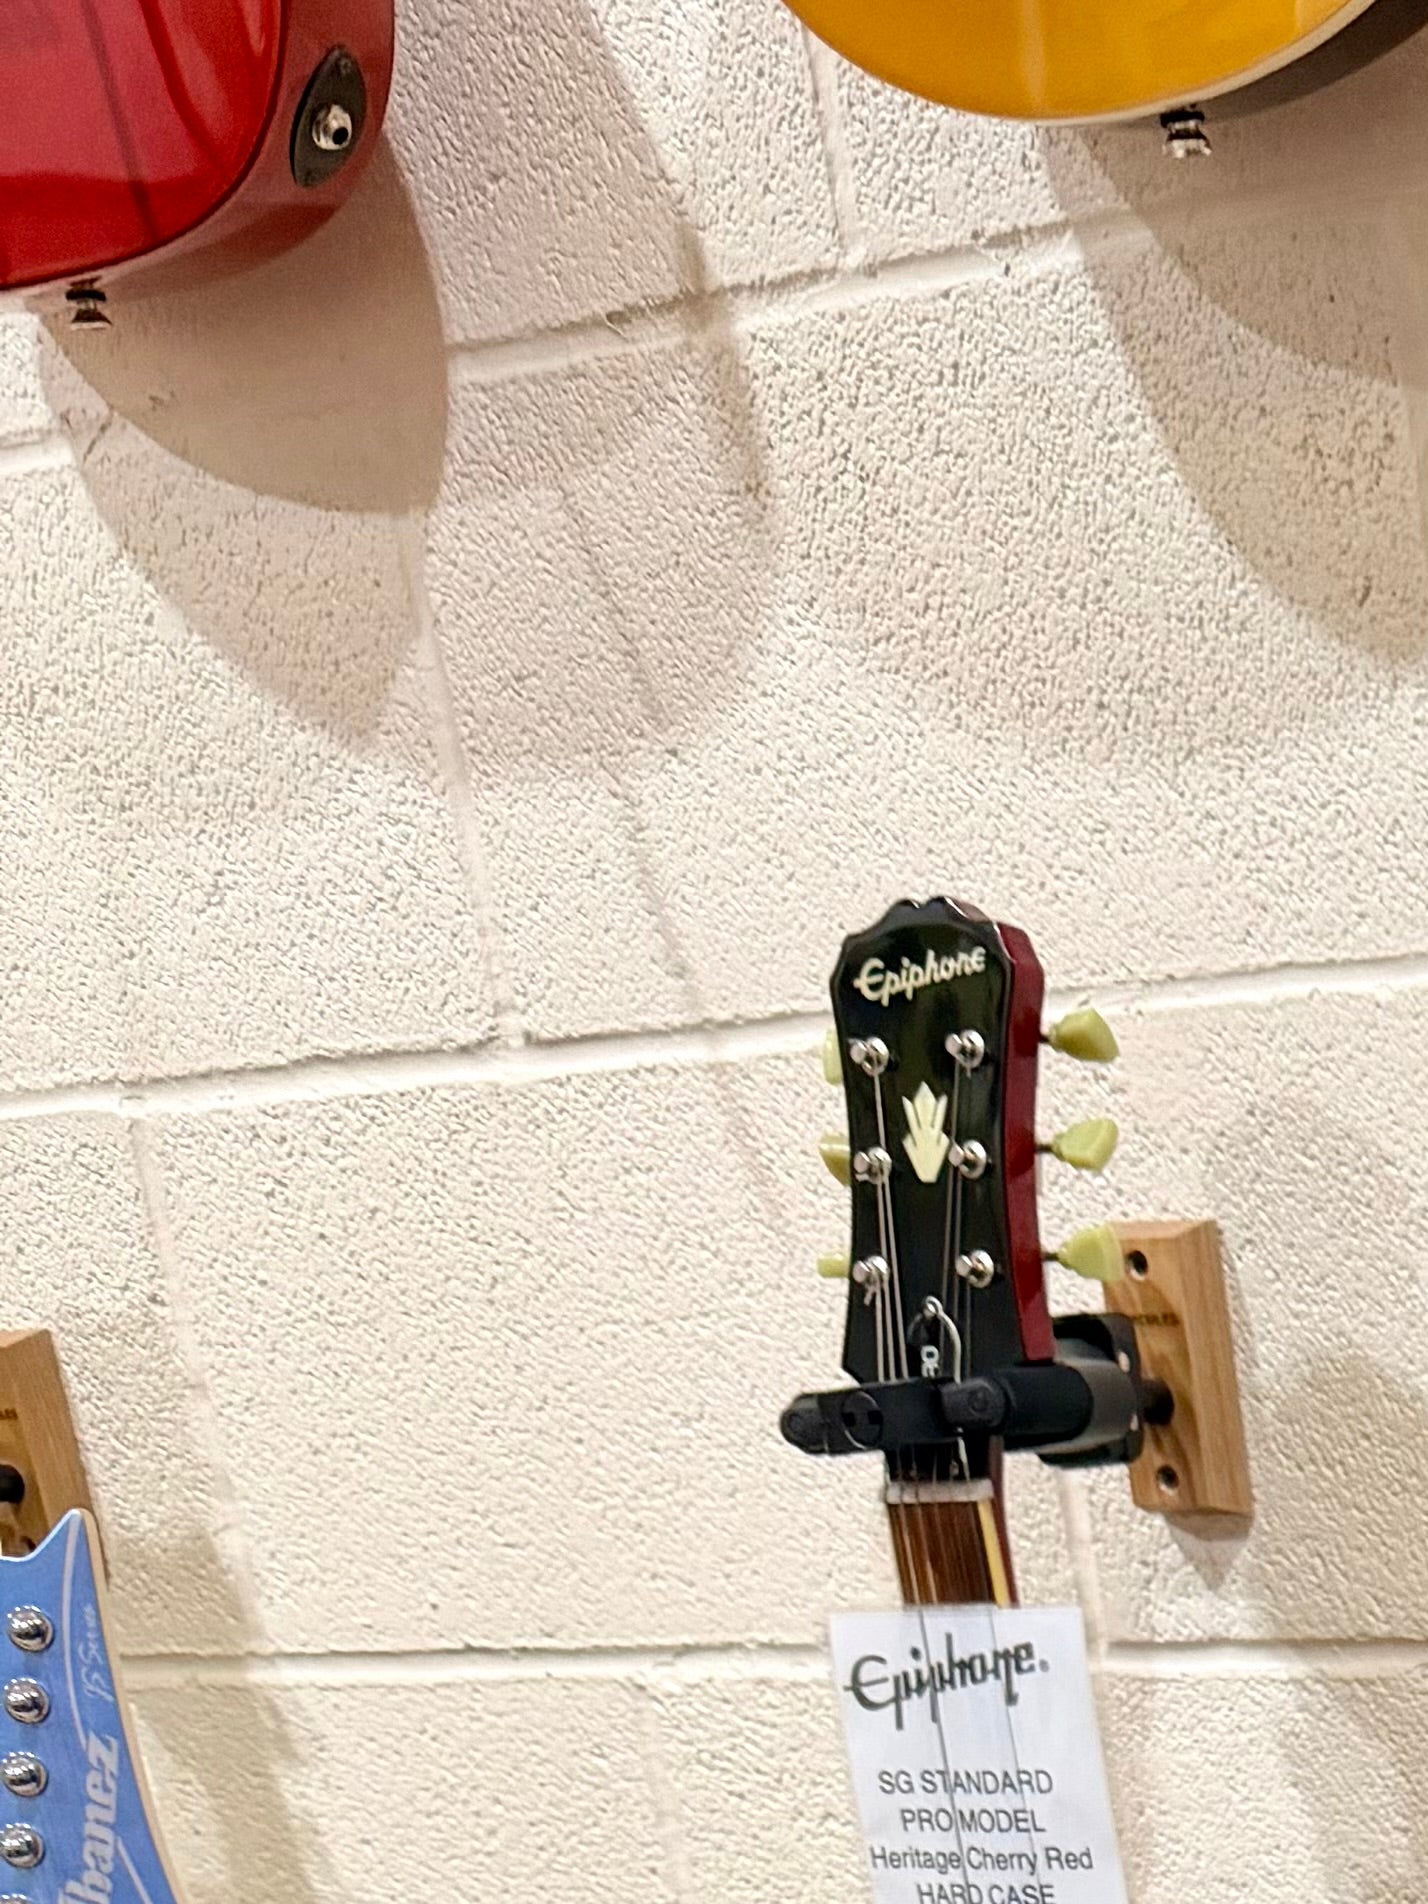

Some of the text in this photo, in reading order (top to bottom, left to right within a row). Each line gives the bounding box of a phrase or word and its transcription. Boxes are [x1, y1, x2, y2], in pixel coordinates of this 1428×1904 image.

[853, 945, 986, 1007] Epiphone
[843, 1632, 1036, 1730] Epiphone
[878, 1769, 1054, 1795] SG STANDARD
[900, 1808, 1047, 1834] PRO MODEL
[870, 1846, 1094, 1876] Heritage Cherry Red
